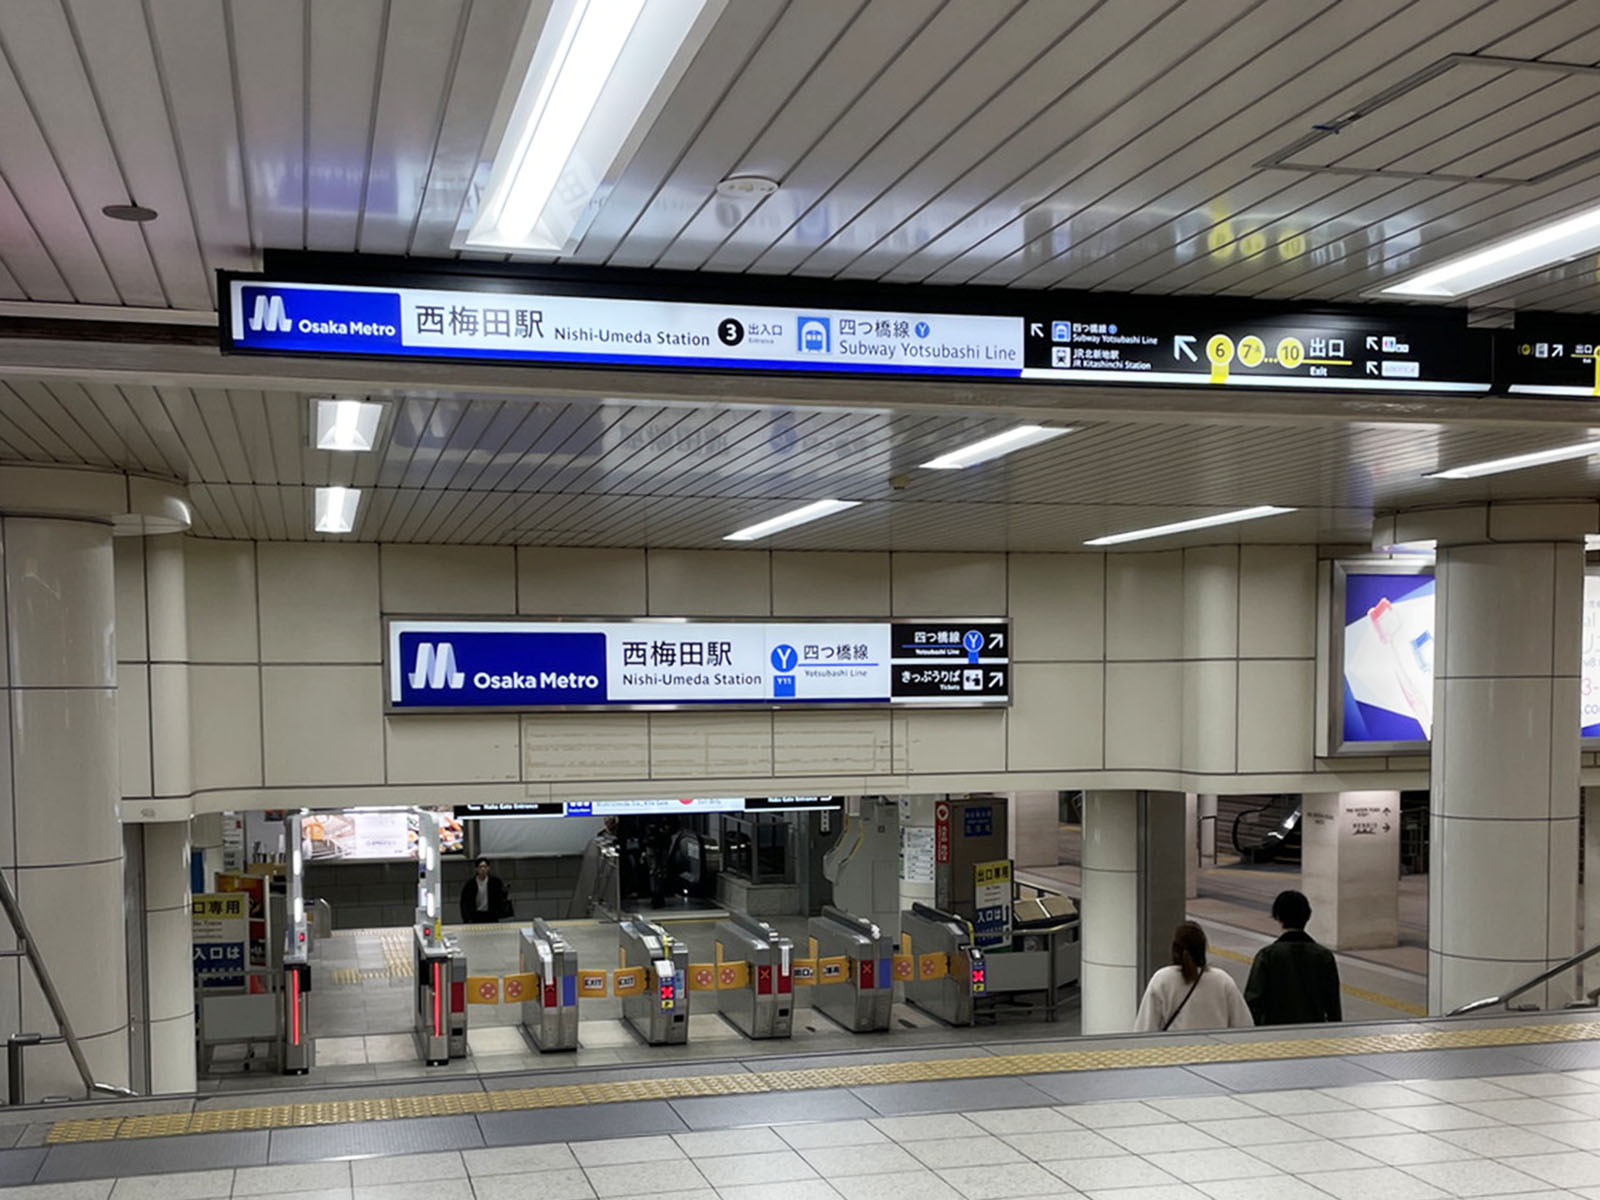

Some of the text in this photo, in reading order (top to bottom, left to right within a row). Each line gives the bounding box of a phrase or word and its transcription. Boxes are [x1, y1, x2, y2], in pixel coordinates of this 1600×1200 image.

[298, 318, 396, 337] Osaka Metro
[415, 304, 544, 339] 西梅田駅
[748, 323, 783, 337] 出入口
[839, 318, 910, 339] 四つ橋線
[917, 323, 928, 337] Y
[554, 327, 710, 346] Nishi-Umeda Station
[724, 323, 737, 340] 3
[839, 340, 1017, 361] Subway Yotsubashi Line
[1215, 342, 1226, 358] 6
[1281, 345, 1300, 361] 10
[1309, 337, 1345, 358] 出口
[1309, 366, 1328, 377] Exit
[968, 633, 980, 649] Y
[622, 640, 732, 667] 西梅田駅
[776, 647, 792, 670] Y
[803, 643, 869, 661] 四つ橋線
[473, 672, 599, 690] Osaka Metro
[622, 673, 762, 687] Nishi-Umeda Station
[804, 669, 868, 678] Yotsubashi Line
[901, 669, 961, 683] きっぷうりば
[193, 946, 241, 961] 入口は
